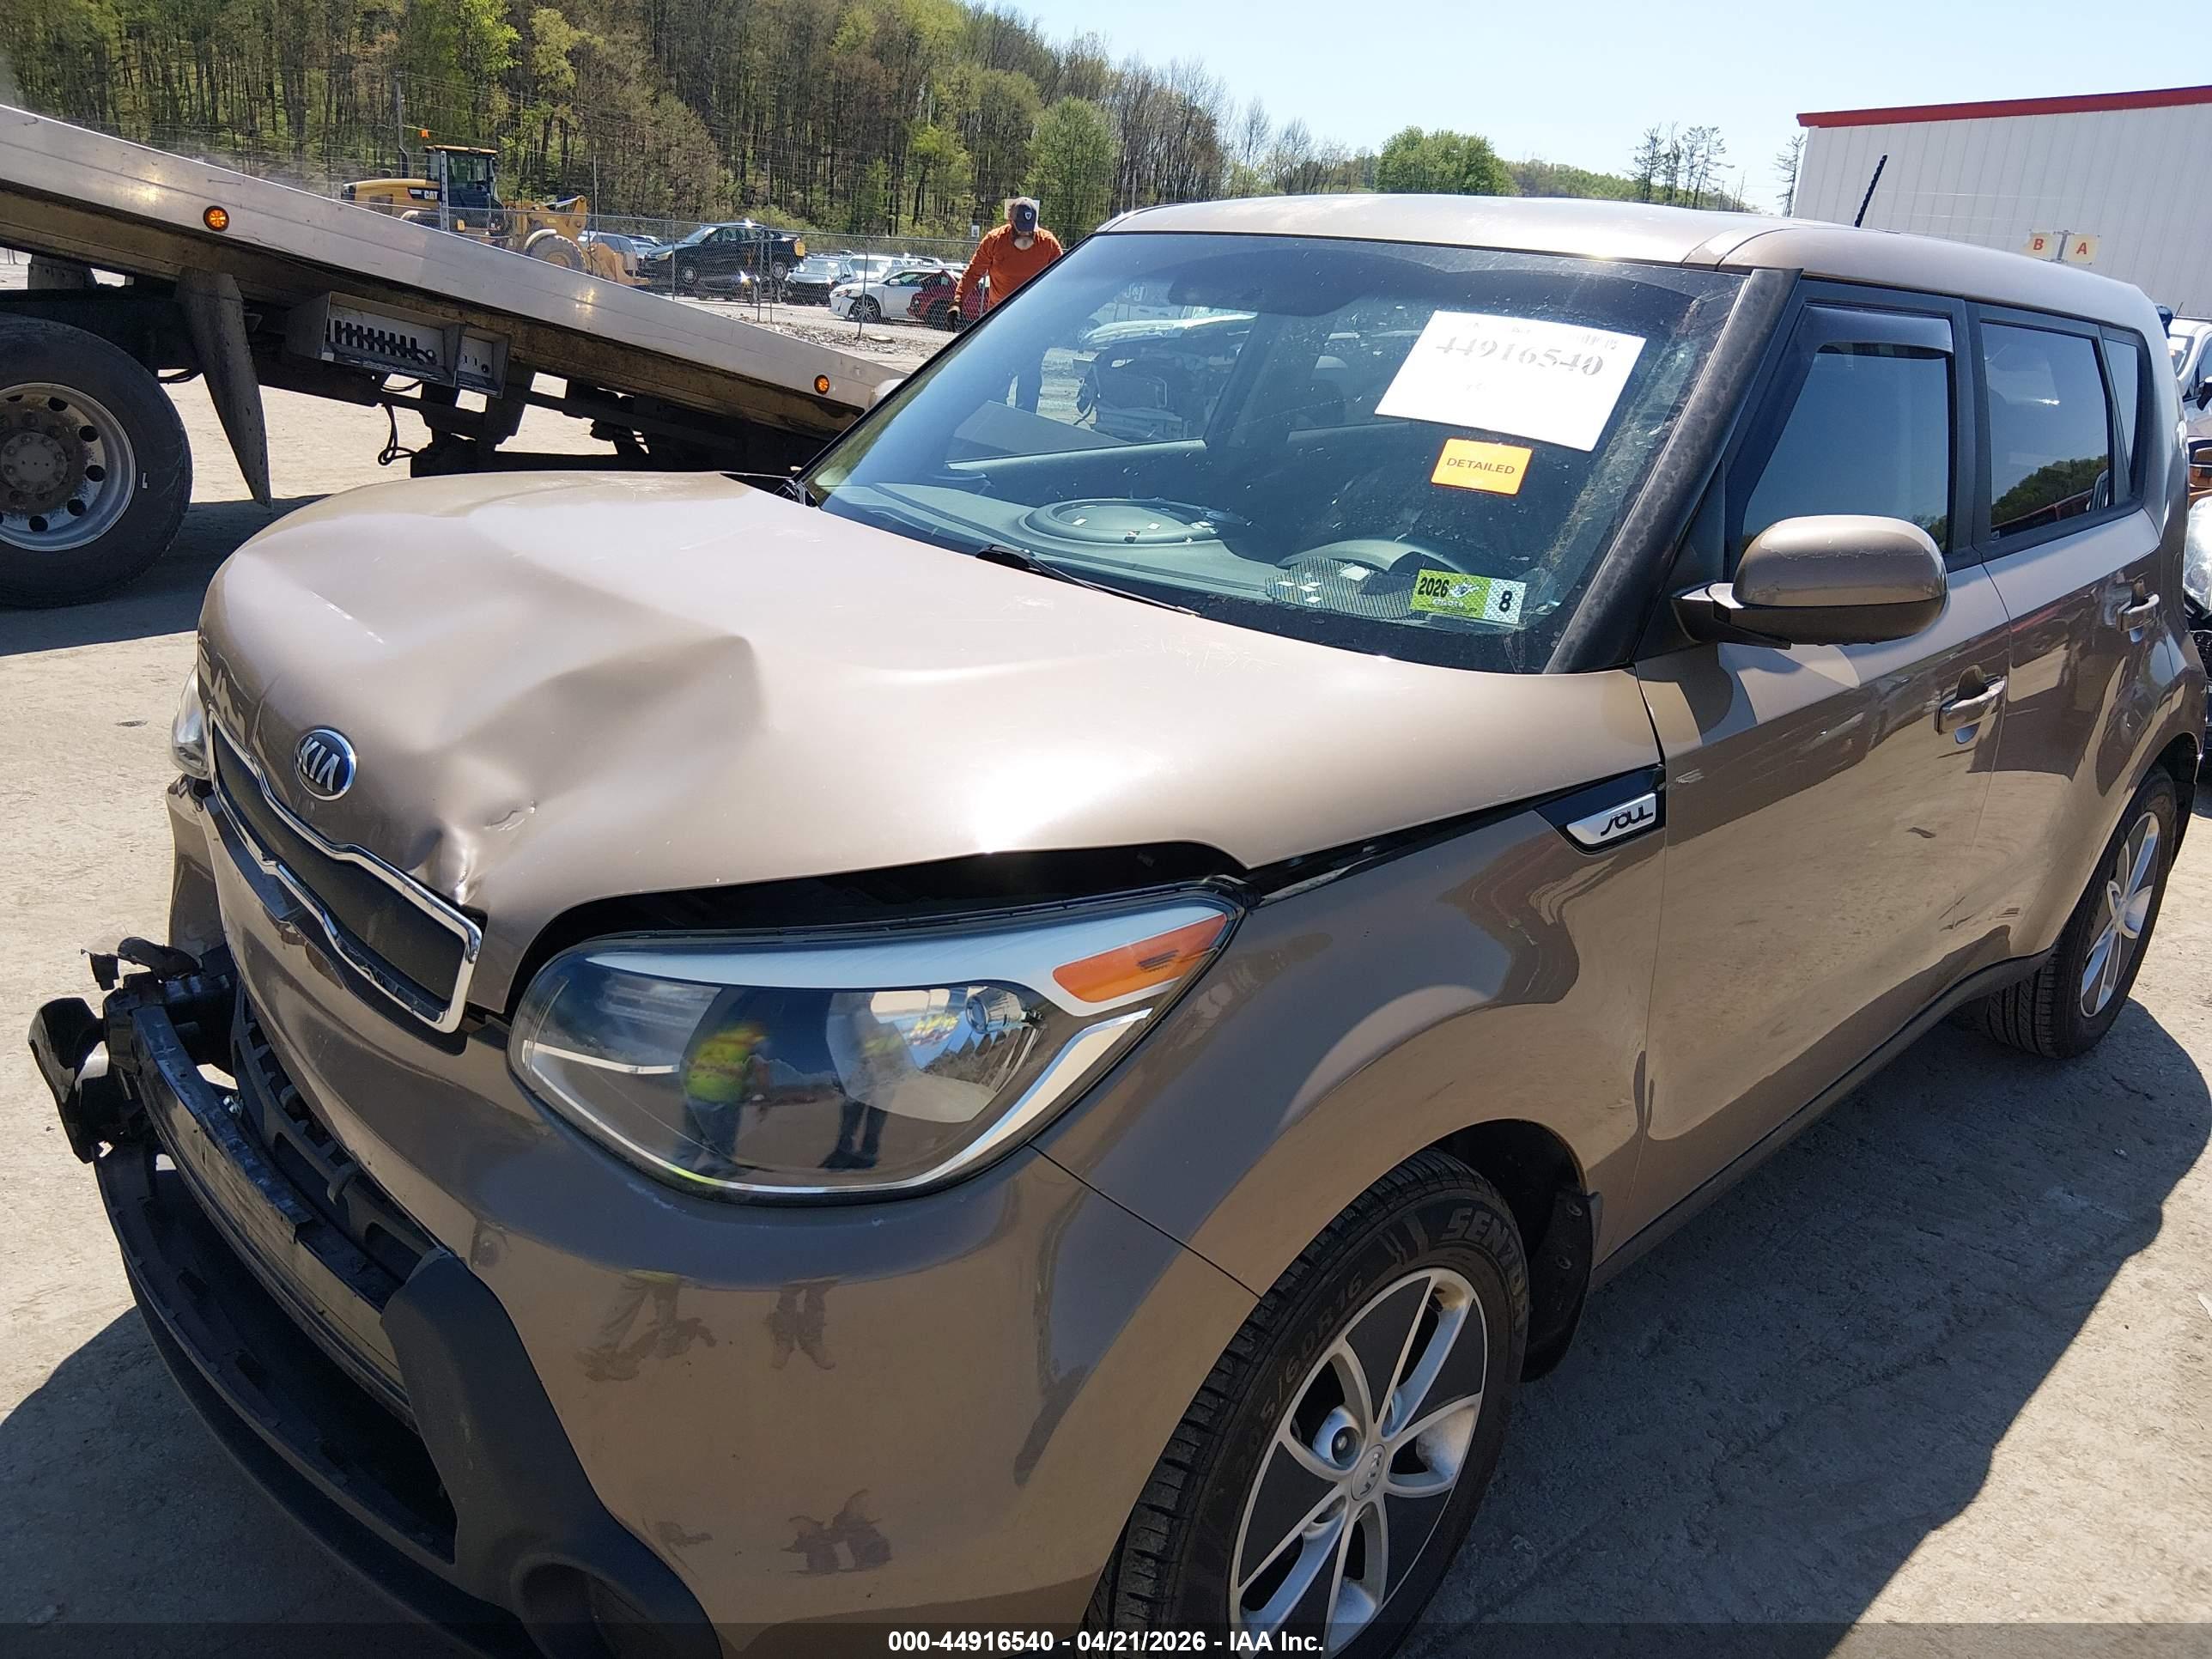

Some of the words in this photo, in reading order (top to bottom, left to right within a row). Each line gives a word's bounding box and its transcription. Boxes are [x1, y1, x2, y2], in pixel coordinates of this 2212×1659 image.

[424, 190, 439, 200] CAT
[2033, 238, 2045, 251] B
[2075, 242, 2087, 255] A
[1436, 336, 1605, 376] 44916540
[1446, 458, 1516, 475] DETAILED
[1418, 576, 1450, 599] 2026
[1498, 590, 1514, 612] 8
[301, 736, 340, 792] KIA
[1600, 805, 1654, 836] SOUL
